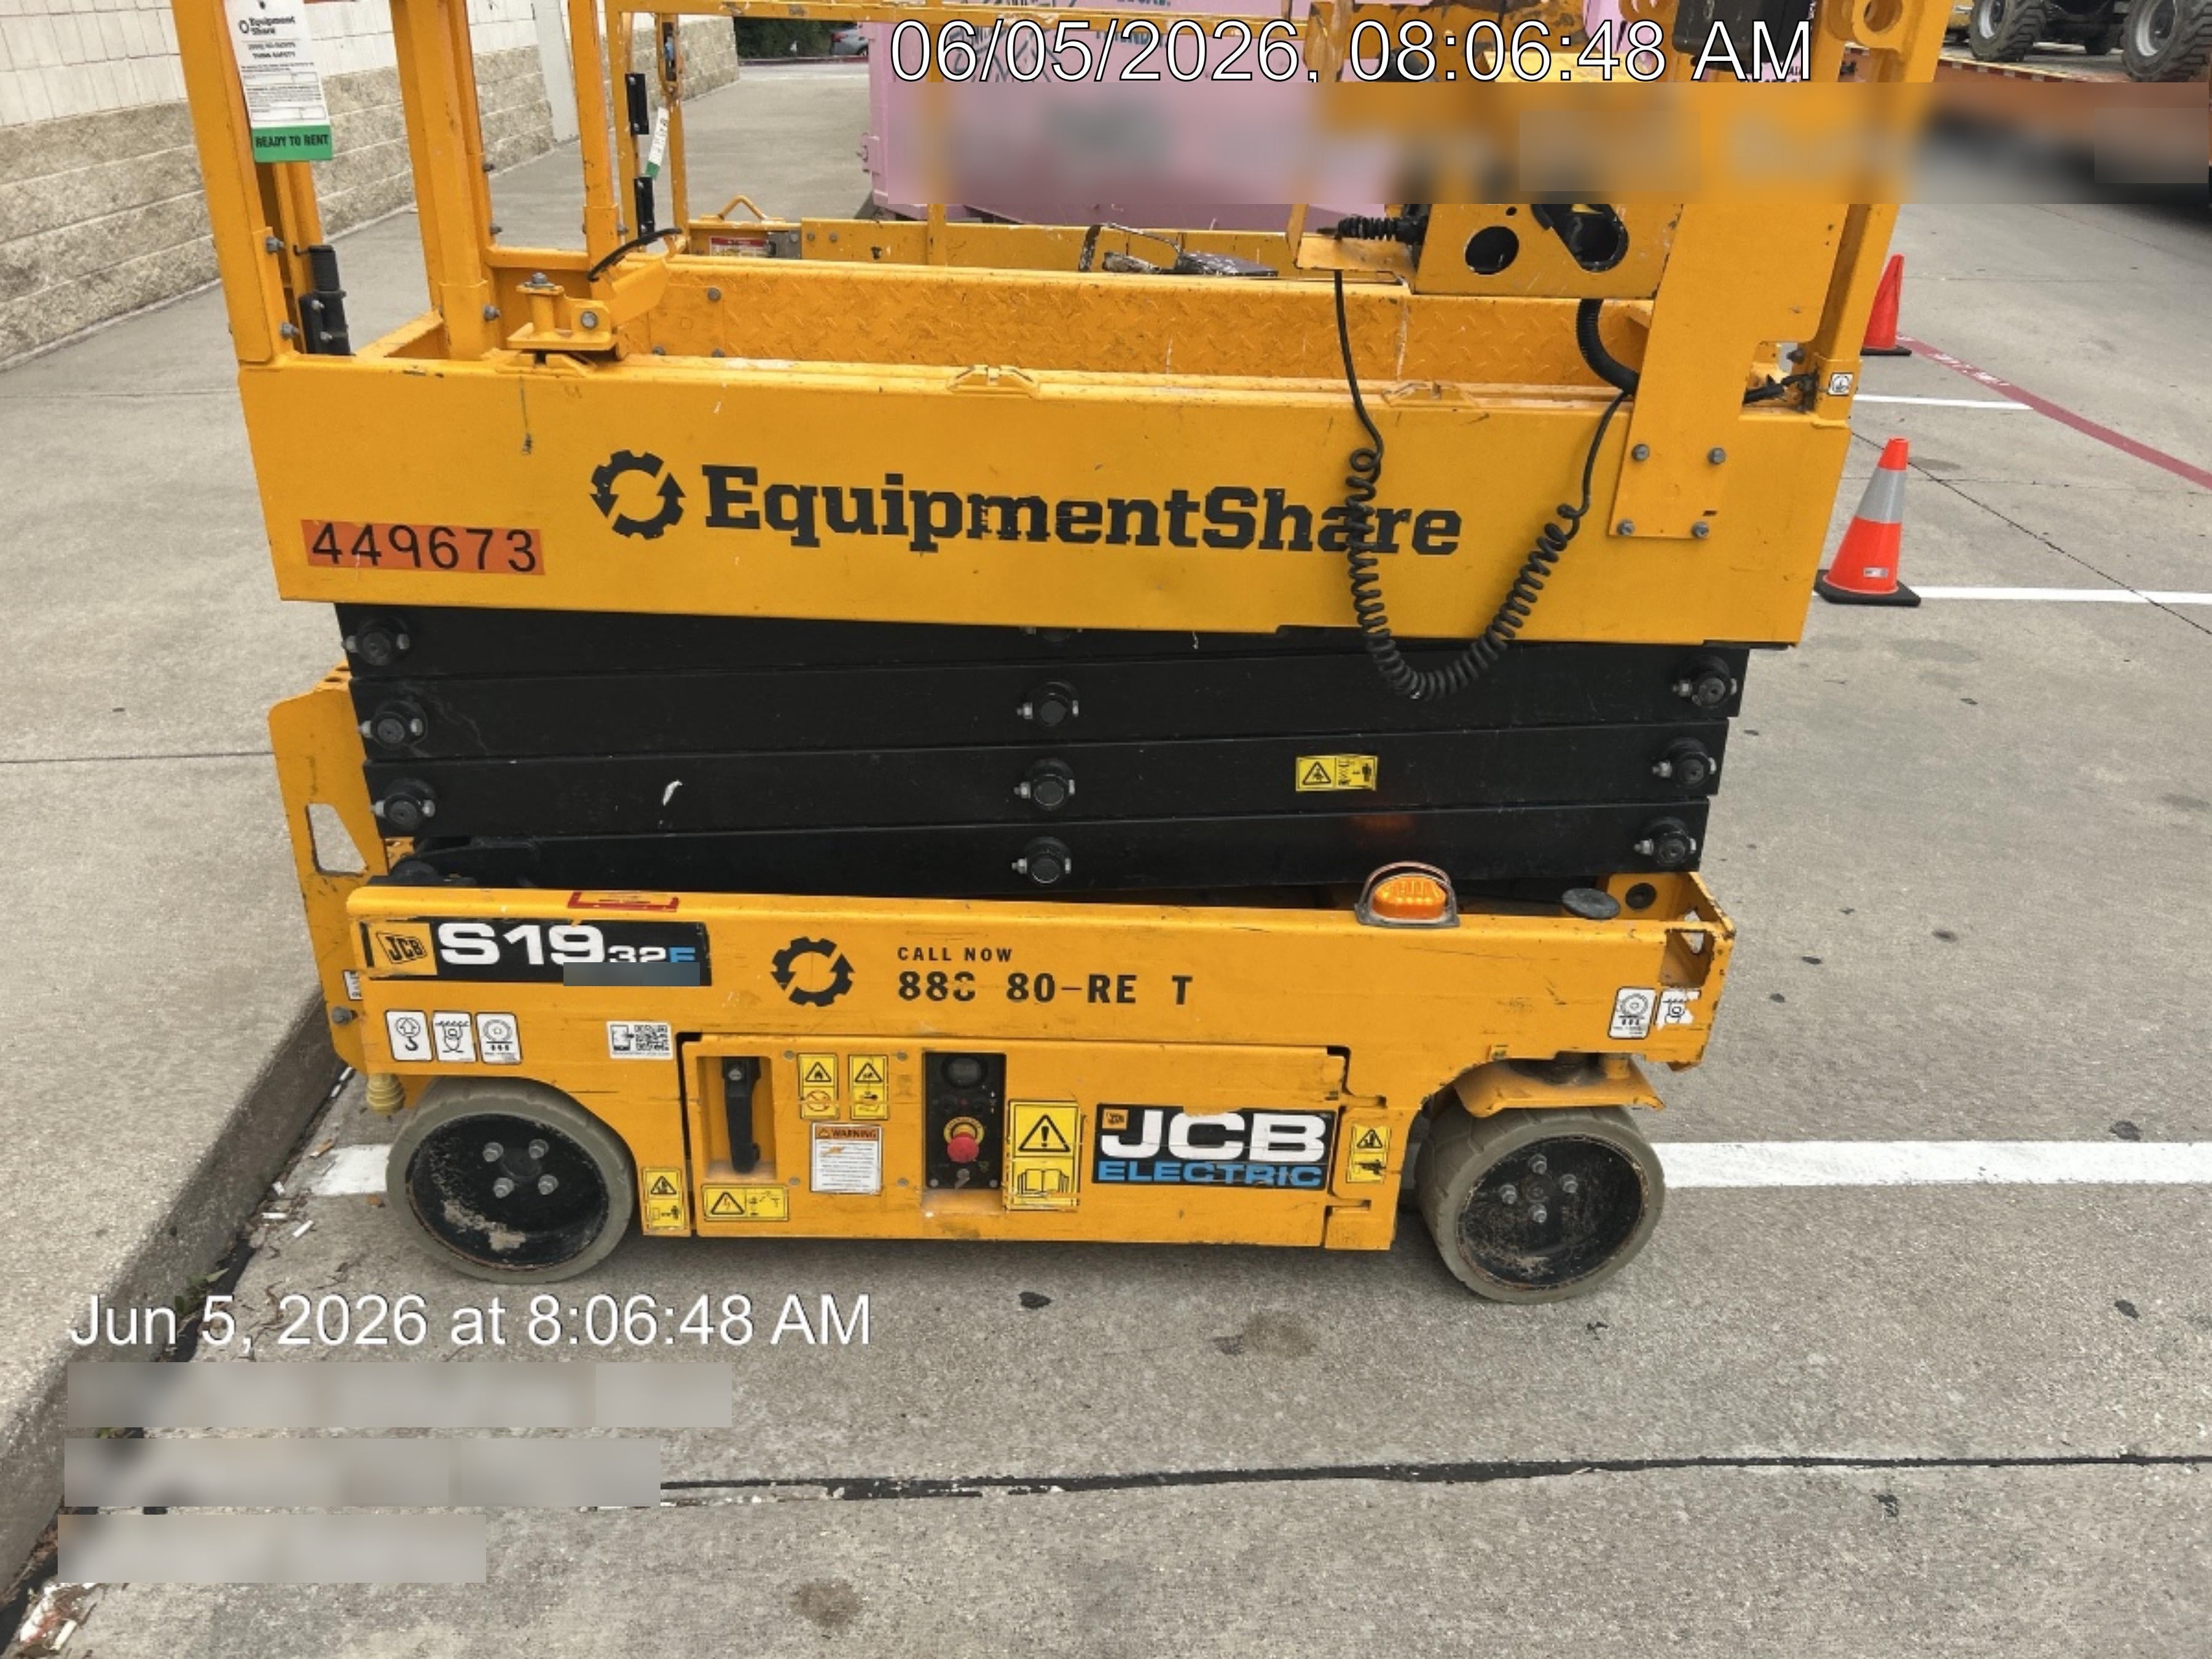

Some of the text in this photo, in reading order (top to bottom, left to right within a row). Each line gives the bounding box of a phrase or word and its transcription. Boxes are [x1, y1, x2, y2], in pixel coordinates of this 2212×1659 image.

[256, 134, 329, 147] READY TO RENT
[702, 465, 1462, 555] EquipmentShare
[312, 522, 536, 573] 449673
[385, 936, 424, 960] JCB
[897, 947, 1013, 962] CALL NOW
[831, 1129, 876, 1138] WARNING
[1100, 1110, 1326, 1162] JCB
[1098, 1161, 1322, 1186] ELECTRIC
